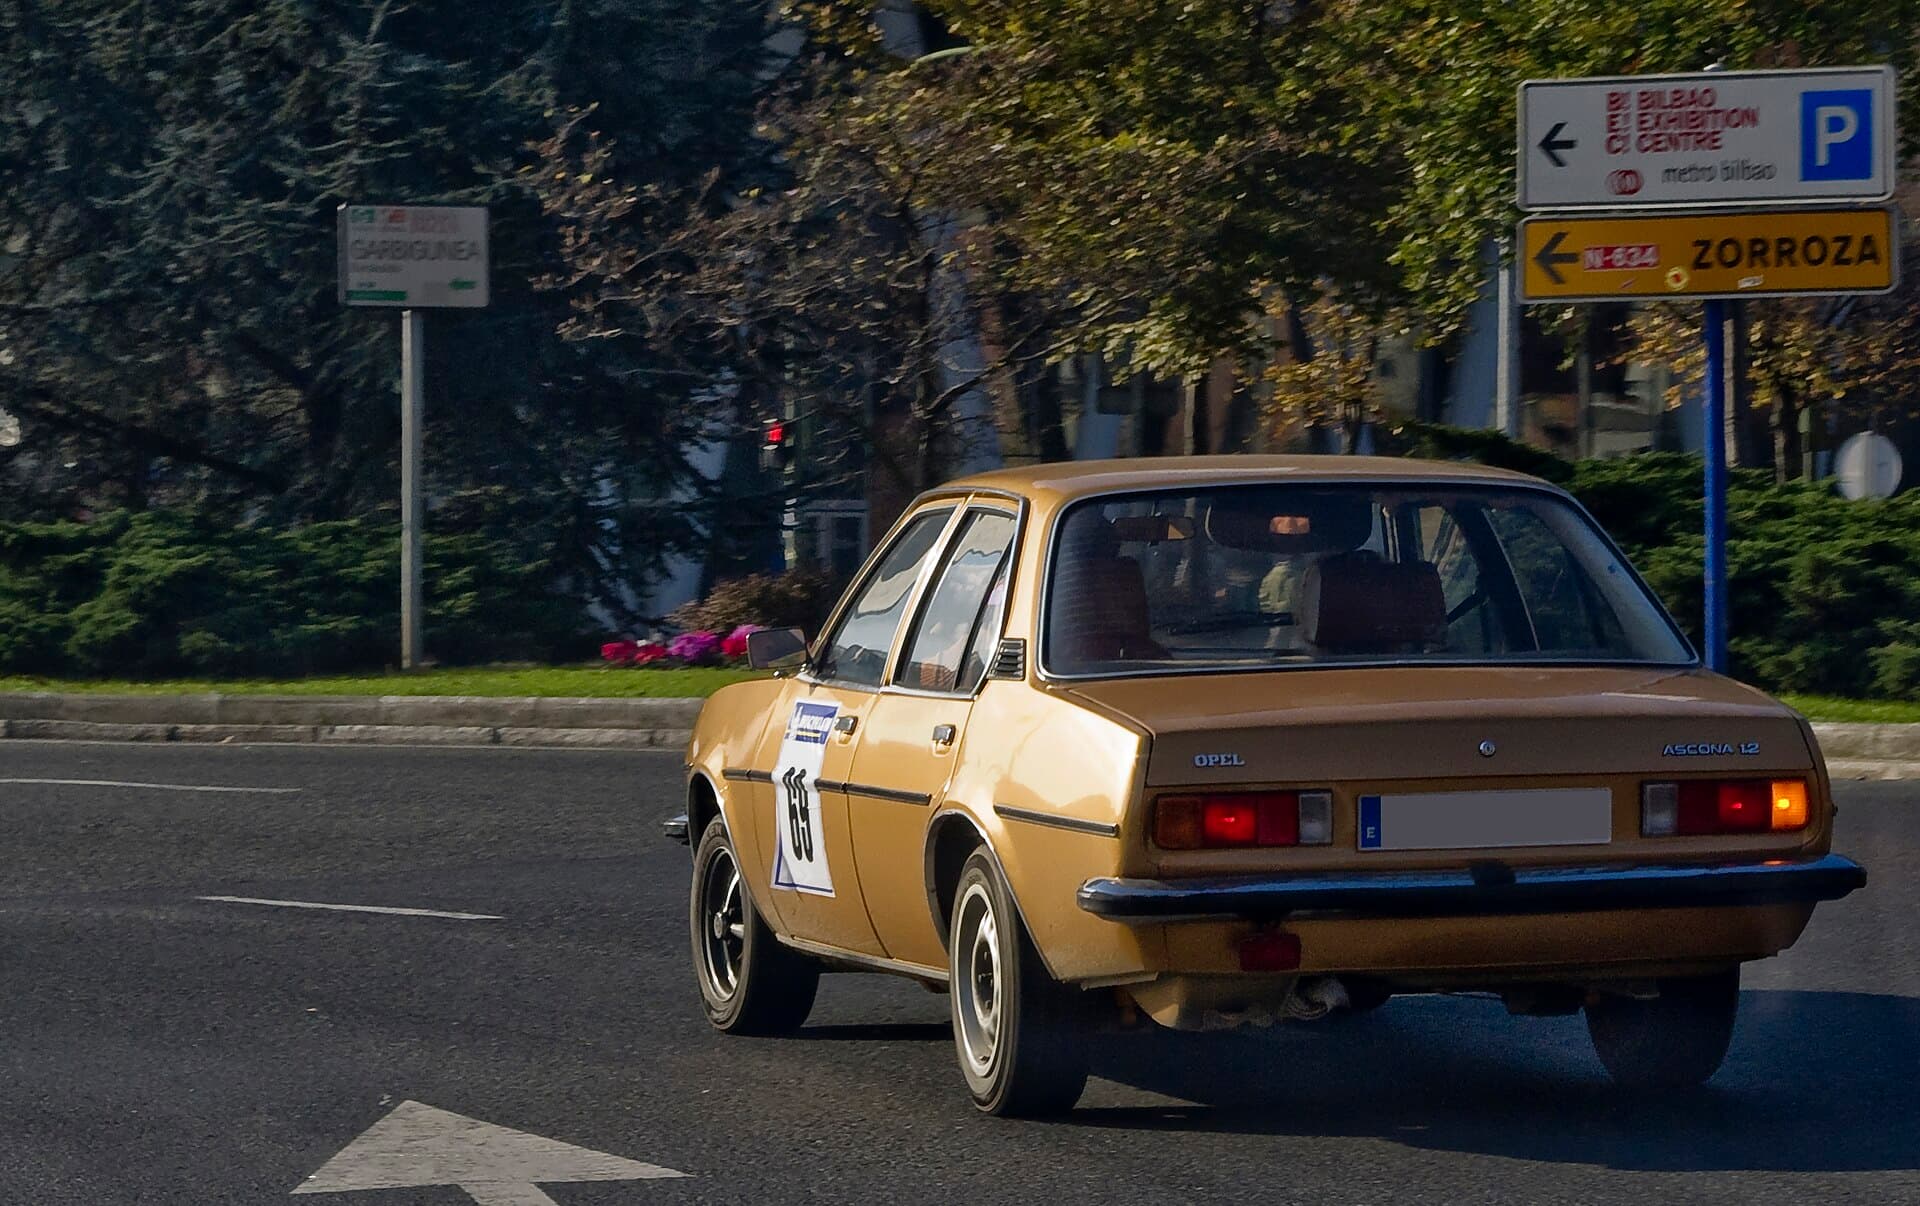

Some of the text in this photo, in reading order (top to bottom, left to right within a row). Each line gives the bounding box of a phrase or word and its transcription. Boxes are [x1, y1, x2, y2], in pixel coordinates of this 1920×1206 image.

[1638, 87, 1716, 109] BILBAO
[1637, 108, 1759, 131] EXHIBITION
[1637, 131, 1723, 152] CENTRE
[1815, 105, 1859, 167] P
[1662, 160, 1777, 183] metro bilbao
[1584, 246, 1659, 269] N-634
[1692, 236, 1880, 270] ZORROZA
[1194, 753, 1246, 767] OPEL
[1663, 743, 1734, 755] ASCONA
[1366, 826, 1376, 839] E
